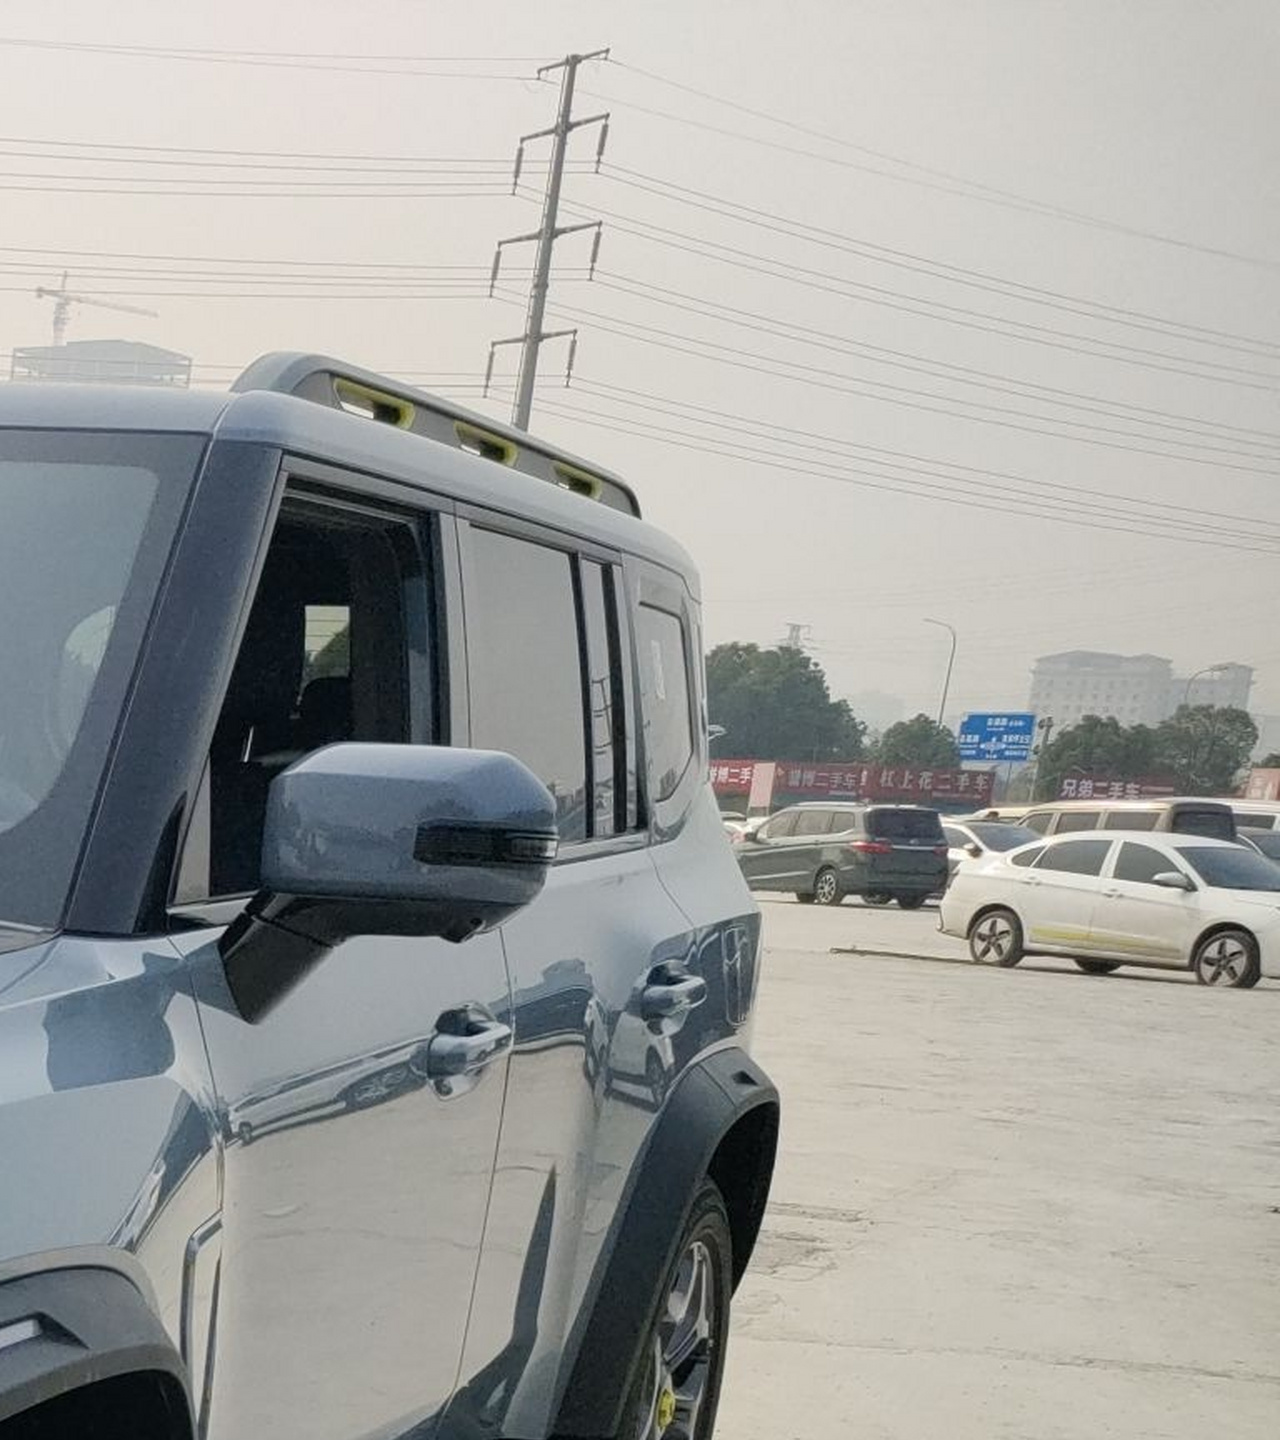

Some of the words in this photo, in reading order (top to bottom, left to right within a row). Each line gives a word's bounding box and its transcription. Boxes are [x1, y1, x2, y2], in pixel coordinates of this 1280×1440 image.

[1060, 778, 1142, 800] 兄弟二手车
